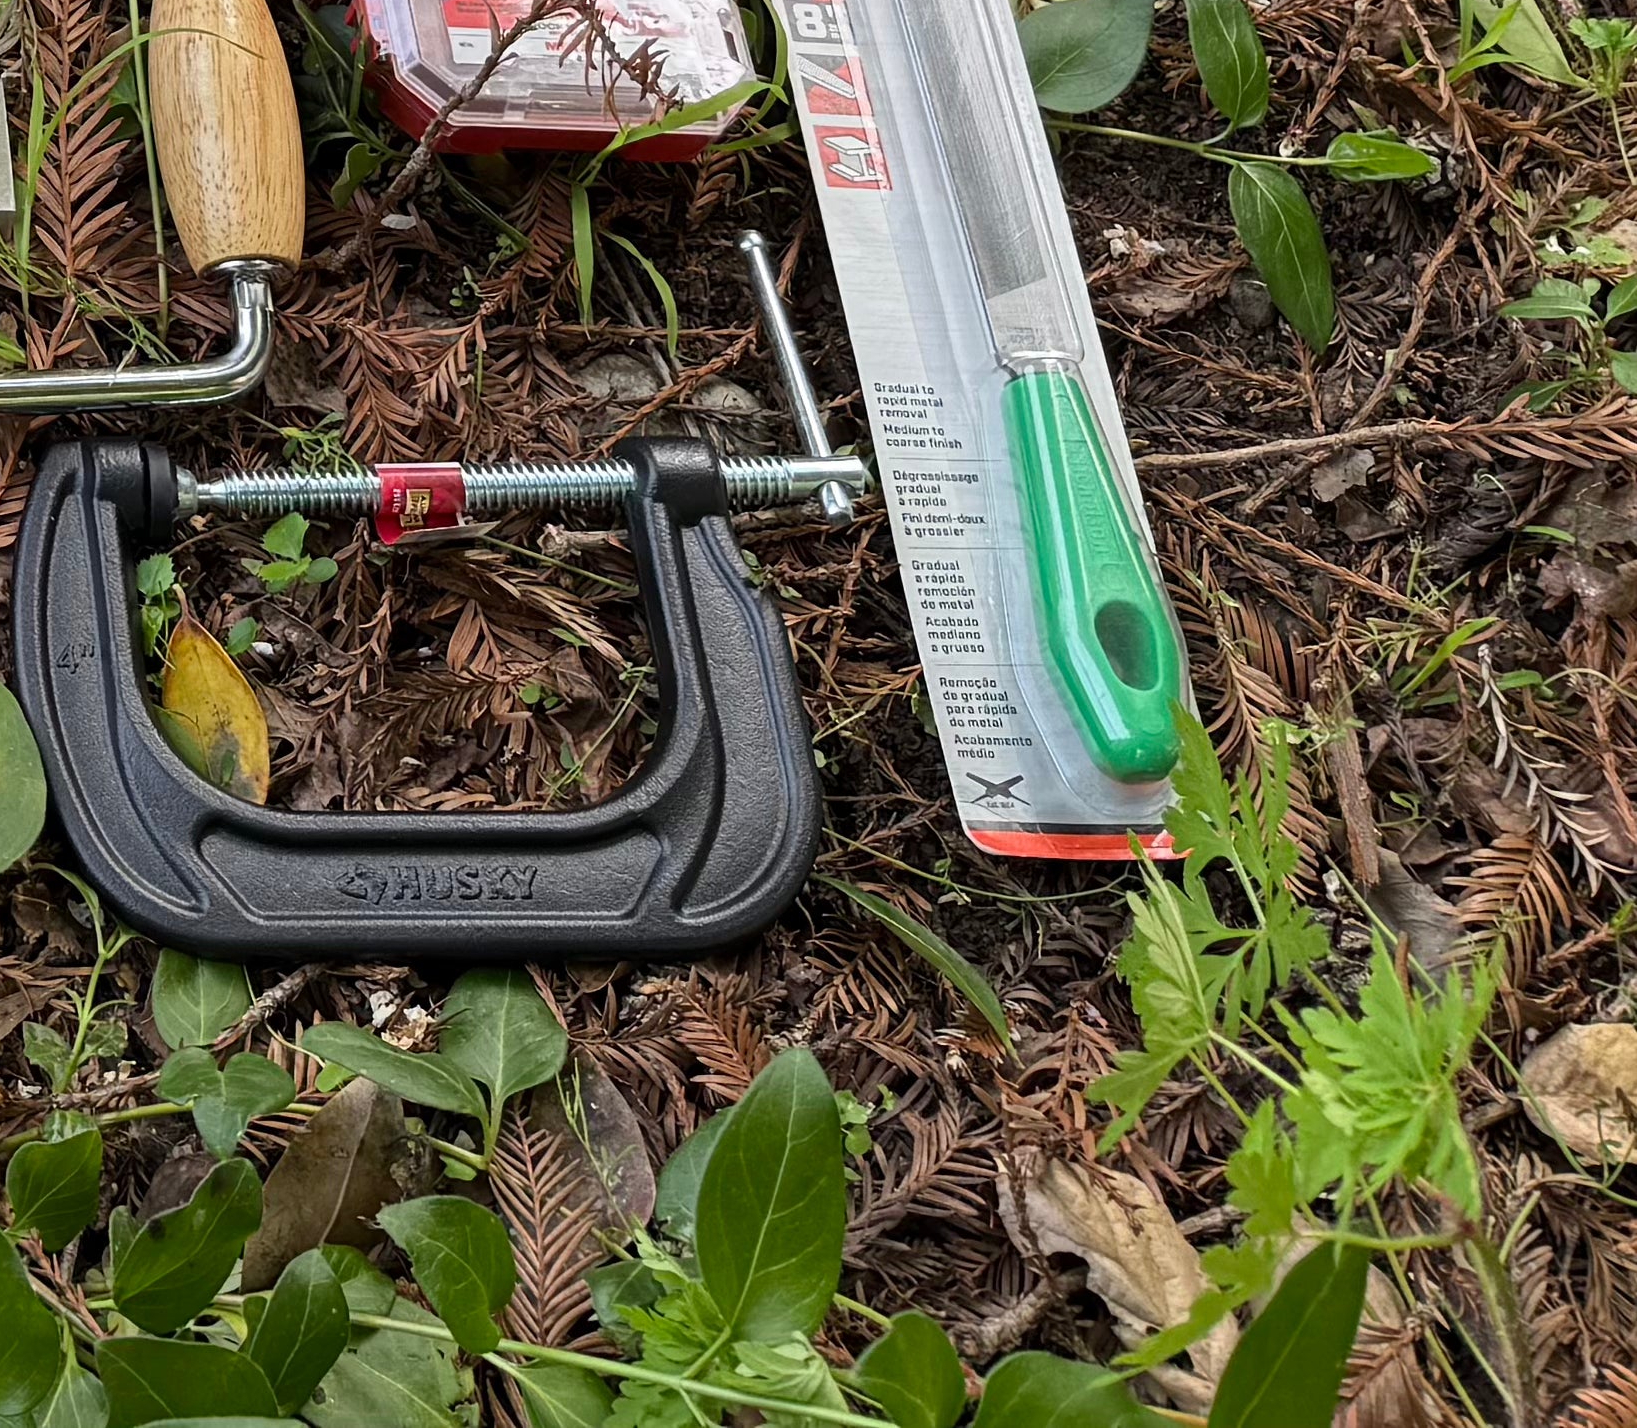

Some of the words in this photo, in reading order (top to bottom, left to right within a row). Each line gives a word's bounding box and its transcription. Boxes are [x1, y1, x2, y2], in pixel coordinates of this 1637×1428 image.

[874, 383, 918, 395] Gradual
[880, 408, 927, 419] removal
[883, 424, 929, 436] Medium
[912, 560, 960, 571] Gradual
[926, 616, 979, 628] Acabado
[954, 734, 1032, 747] Acabamento
[957, 748, 995, 759] médio
[388, 865, 538, 901] HUSKY
